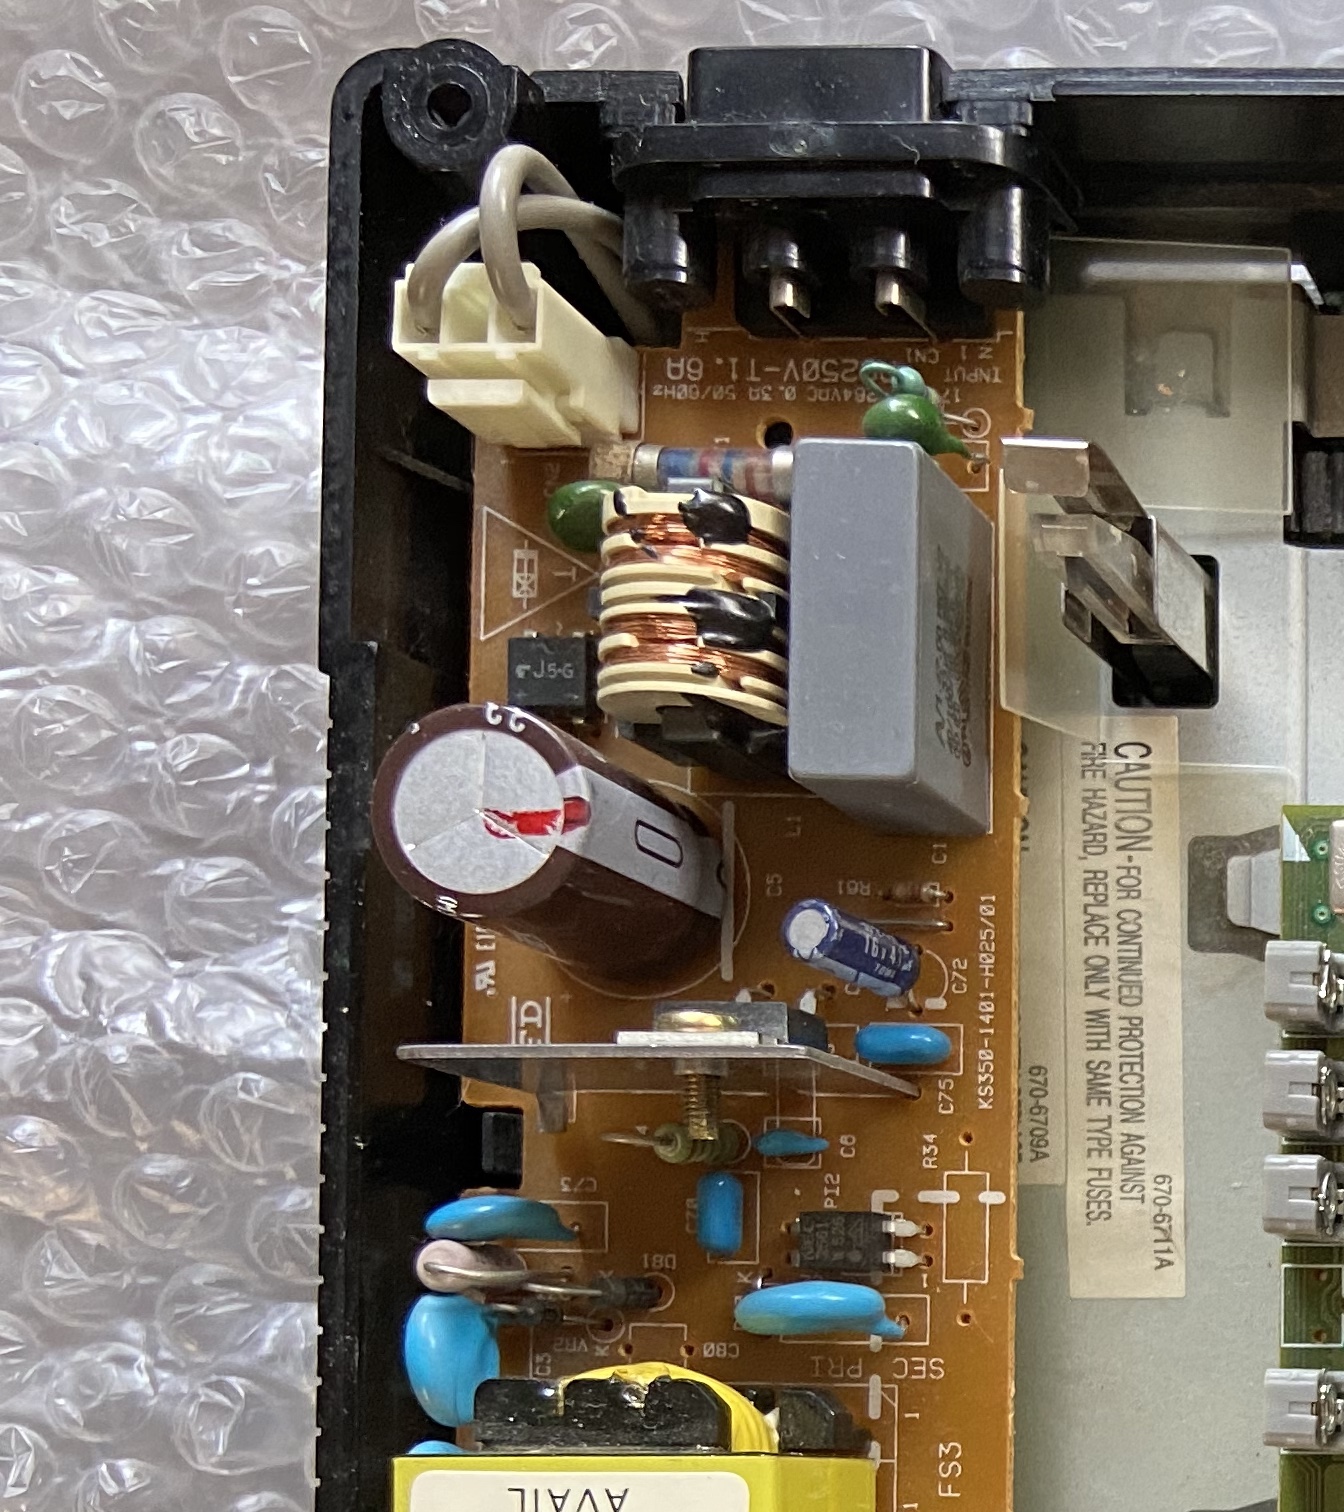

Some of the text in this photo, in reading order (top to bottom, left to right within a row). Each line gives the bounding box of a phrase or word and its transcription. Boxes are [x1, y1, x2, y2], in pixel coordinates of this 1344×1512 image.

[906, 347, 940, 364] CN1
[945, 367, 1001, 384] INPUT
[766, 871, 783, 896] C5
[952, 957, 968, 994] C72
[1118, 909, 1144, 1008] CONTINUED
[1078, 741, 1113, 1228] FIRE HAZARD, REPLACE ONLY WITH SAME TYPE FUSES.
[1119, 1016, 1146, 1124] PROTECTION
[938, 1077, 955, 1115] C75
[1028, 1064, 1051, 1164] 670-6709A
[921, 1133, 940, 1169] R34
[1119, 1131, 1147, 1205] AGAINST
[823, 1172, 842, 1208] PI2
[1152, 1173, 1176, 1271] 670-6711A
[810, 1355, 863, 1379] PRI
[891, 1356, 946, 1380] SEC
[938, 1441, 962, 1498] FS3
